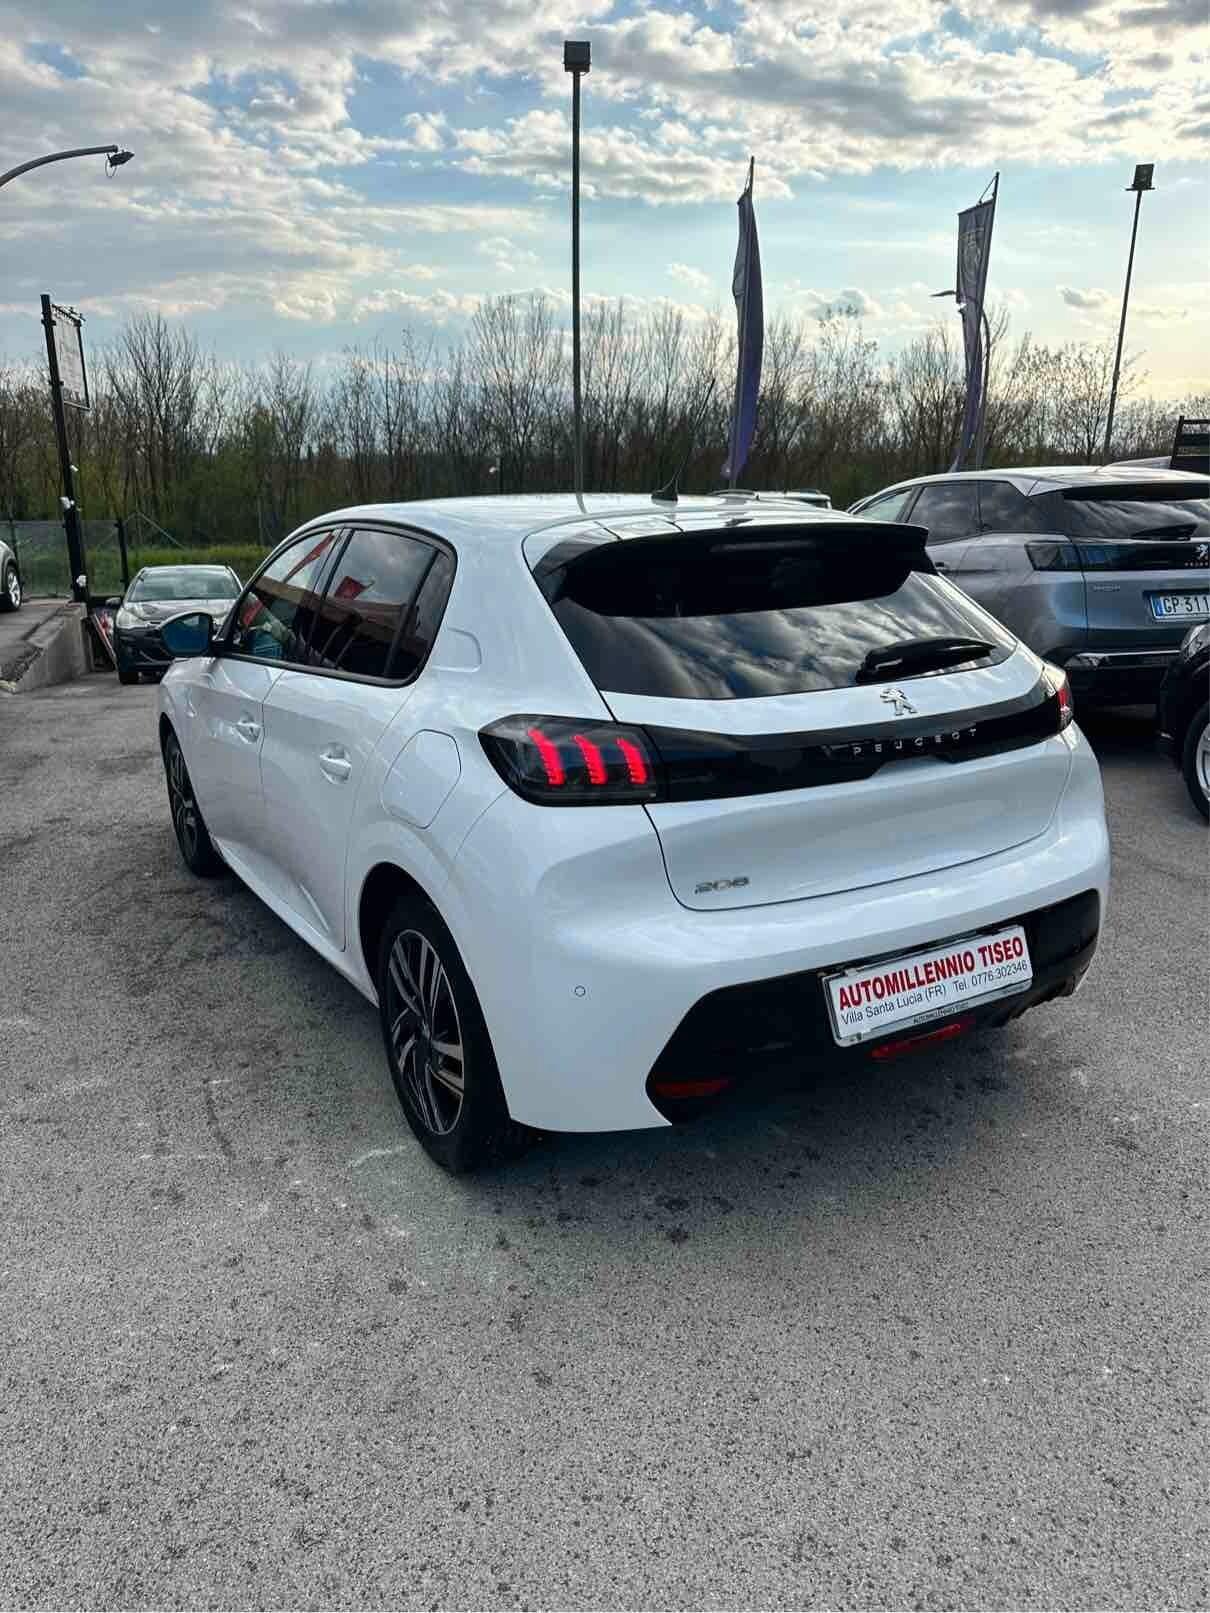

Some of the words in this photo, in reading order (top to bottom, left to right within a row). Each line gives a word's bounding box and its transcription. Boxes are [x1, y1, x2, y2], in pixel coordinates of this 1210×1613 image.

[853, 728, 977, 755] PEUGEOT
[839, 951, 975, 1010] AUTOMILLENNIO
[977, 936, 1023, 967] TISEO
[841, 1010, 864, 1025] Villa
[865, 1001, 895, 1018] Santa
[897, 992, 923, 1008] Lucia
[925, 983, 946, 1002] (FR)
[953, 978, 970, 992] Tel.
